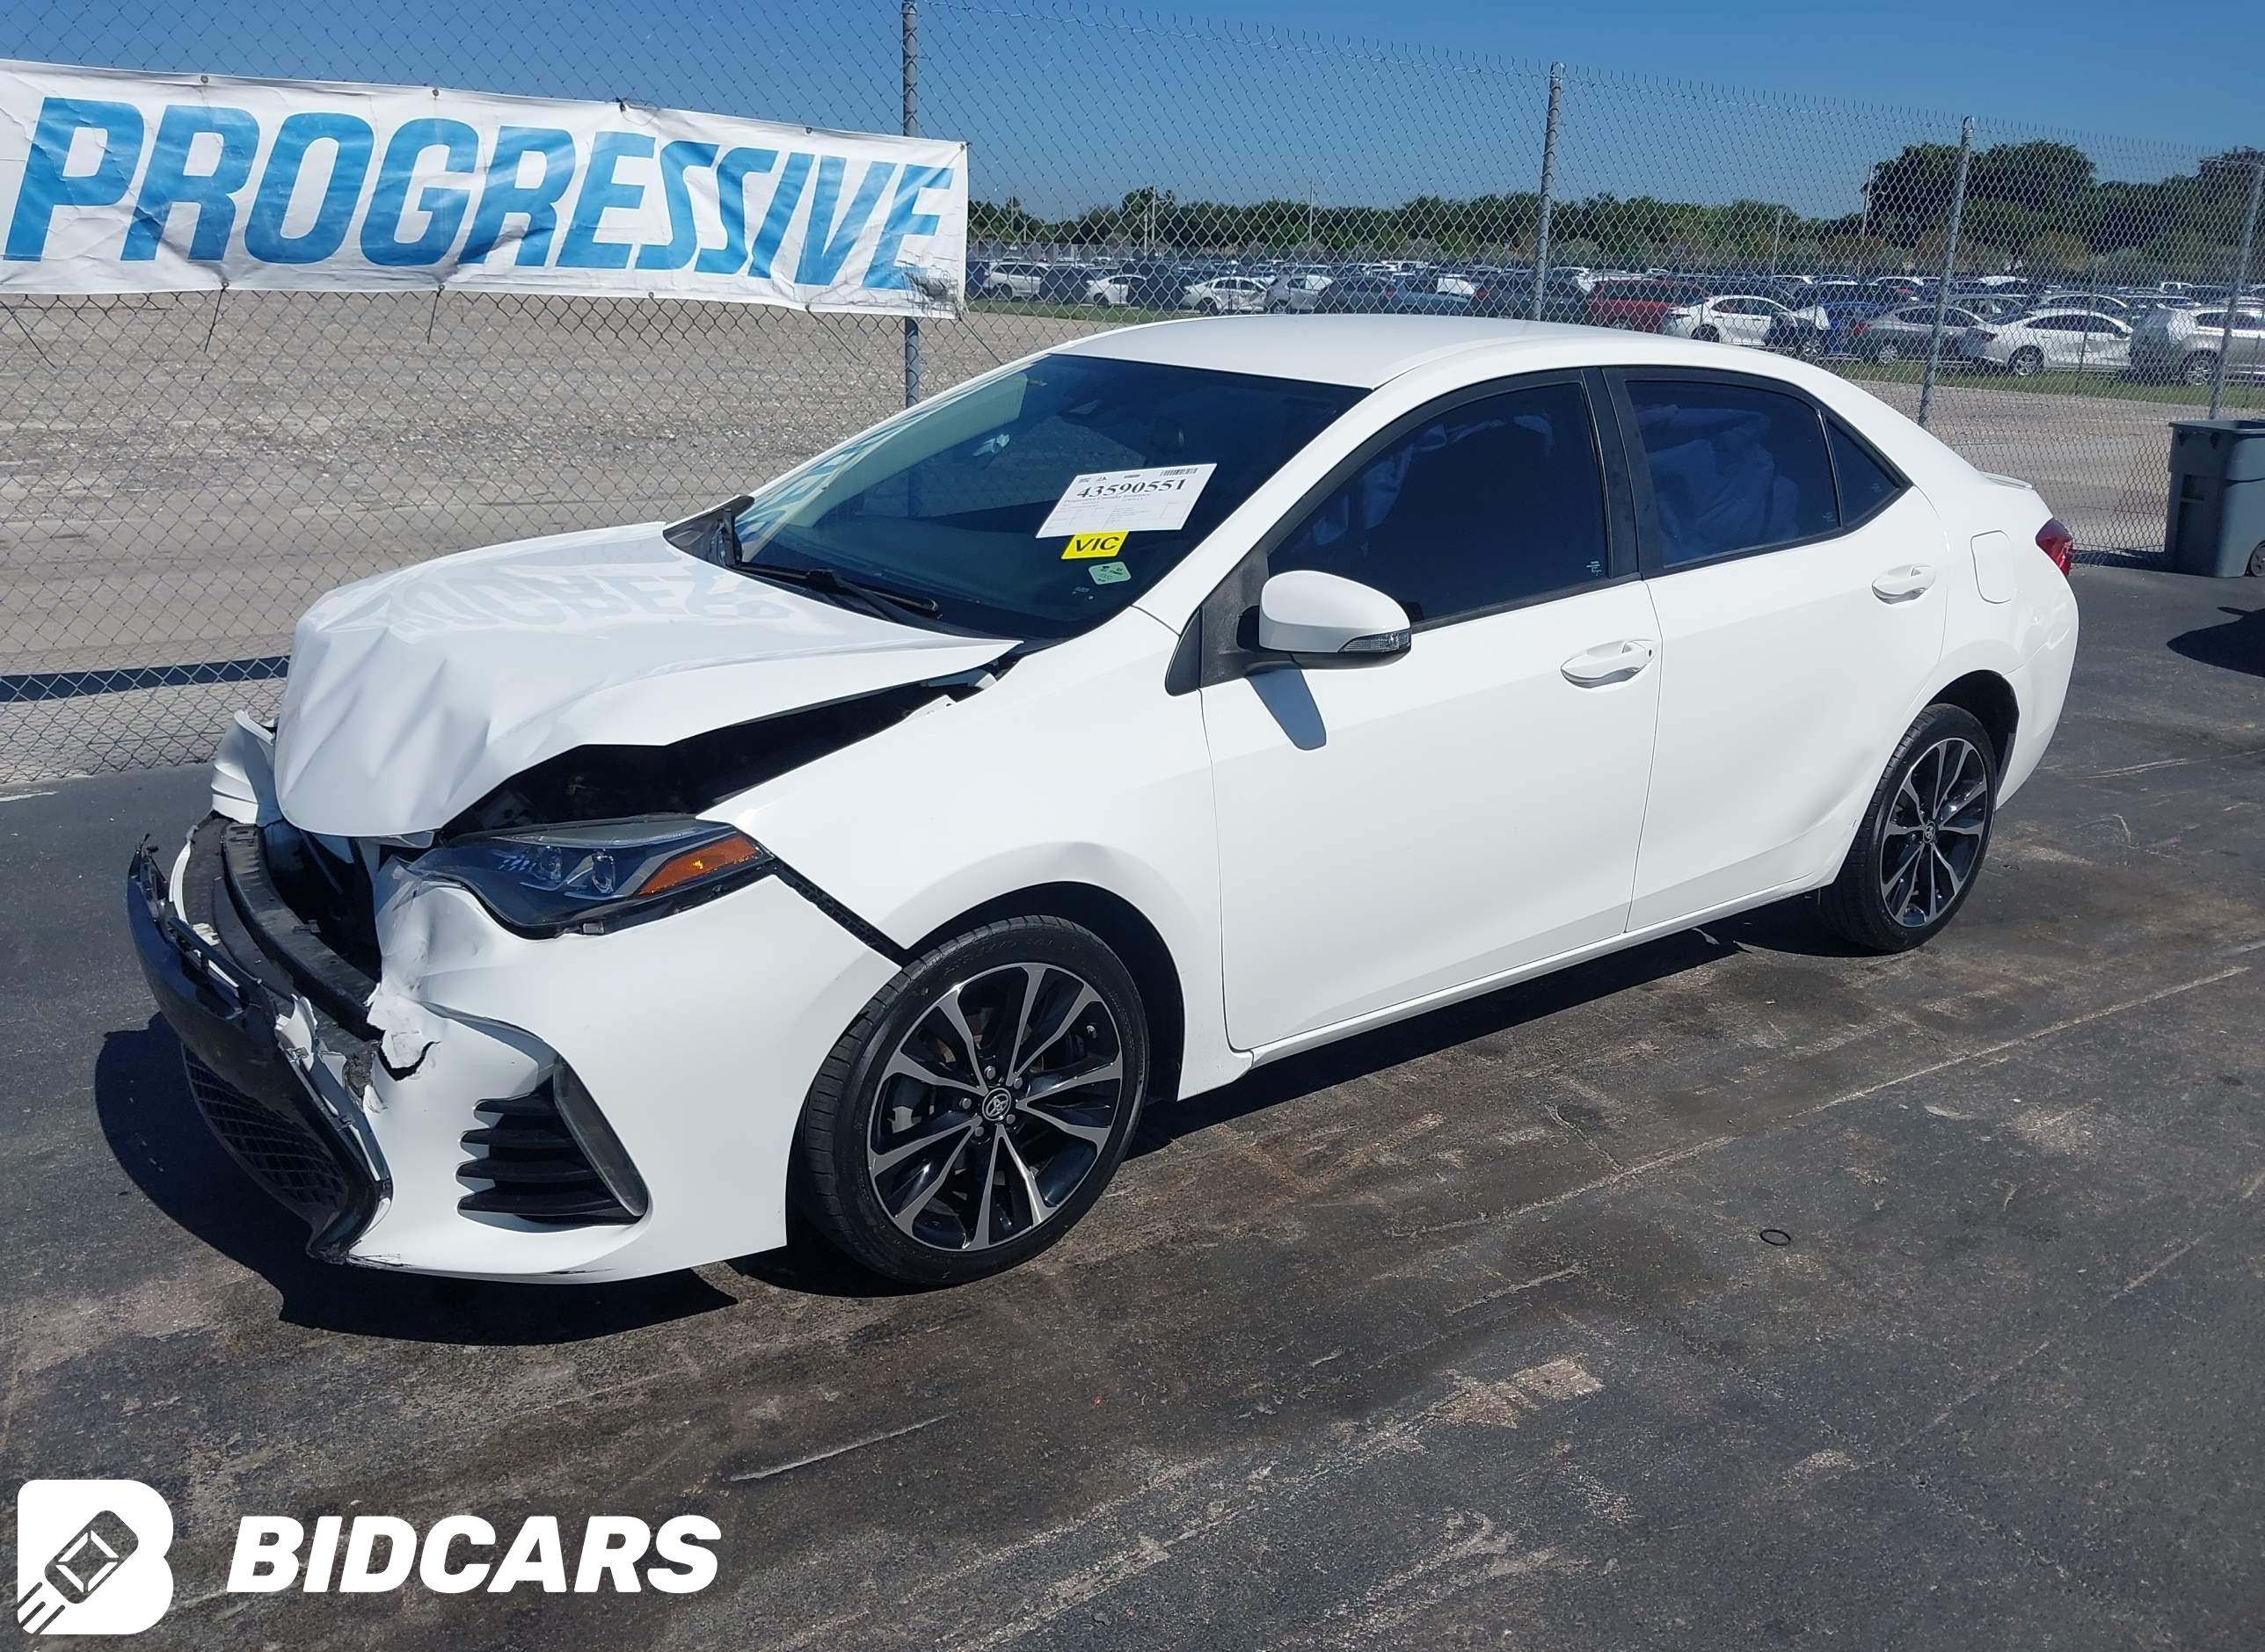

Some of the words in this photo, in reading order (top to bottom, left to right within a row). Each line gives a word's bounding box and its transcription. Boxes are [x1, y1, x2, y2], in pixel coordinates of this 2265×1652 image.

[3, 96, 953, 290] PROGRESSIVE
[1076, 478, 1187, 499] 43590551
[1074, 536, 1120, 552] VIC
